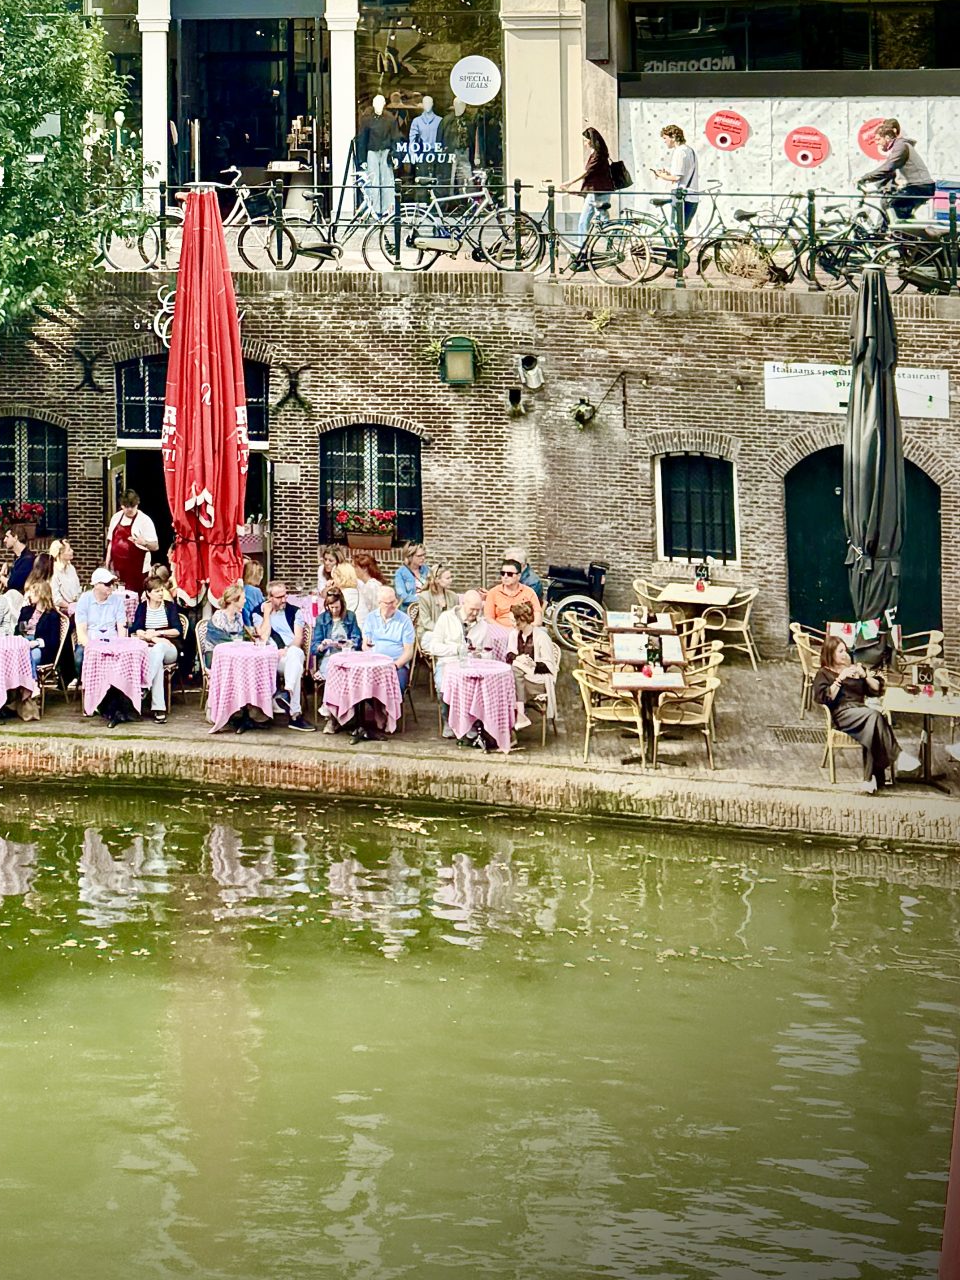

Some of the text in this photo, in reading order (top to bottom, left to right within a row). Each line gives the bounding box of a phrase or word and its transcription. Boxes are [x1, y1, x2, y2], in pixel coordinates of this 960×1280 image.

[396, 143, 443, 152] MODE
[402, 153, 457, 164] AMOUR
[772, 365, 815, 376] Italiaans
[897, 372, 941, 381] staurant
